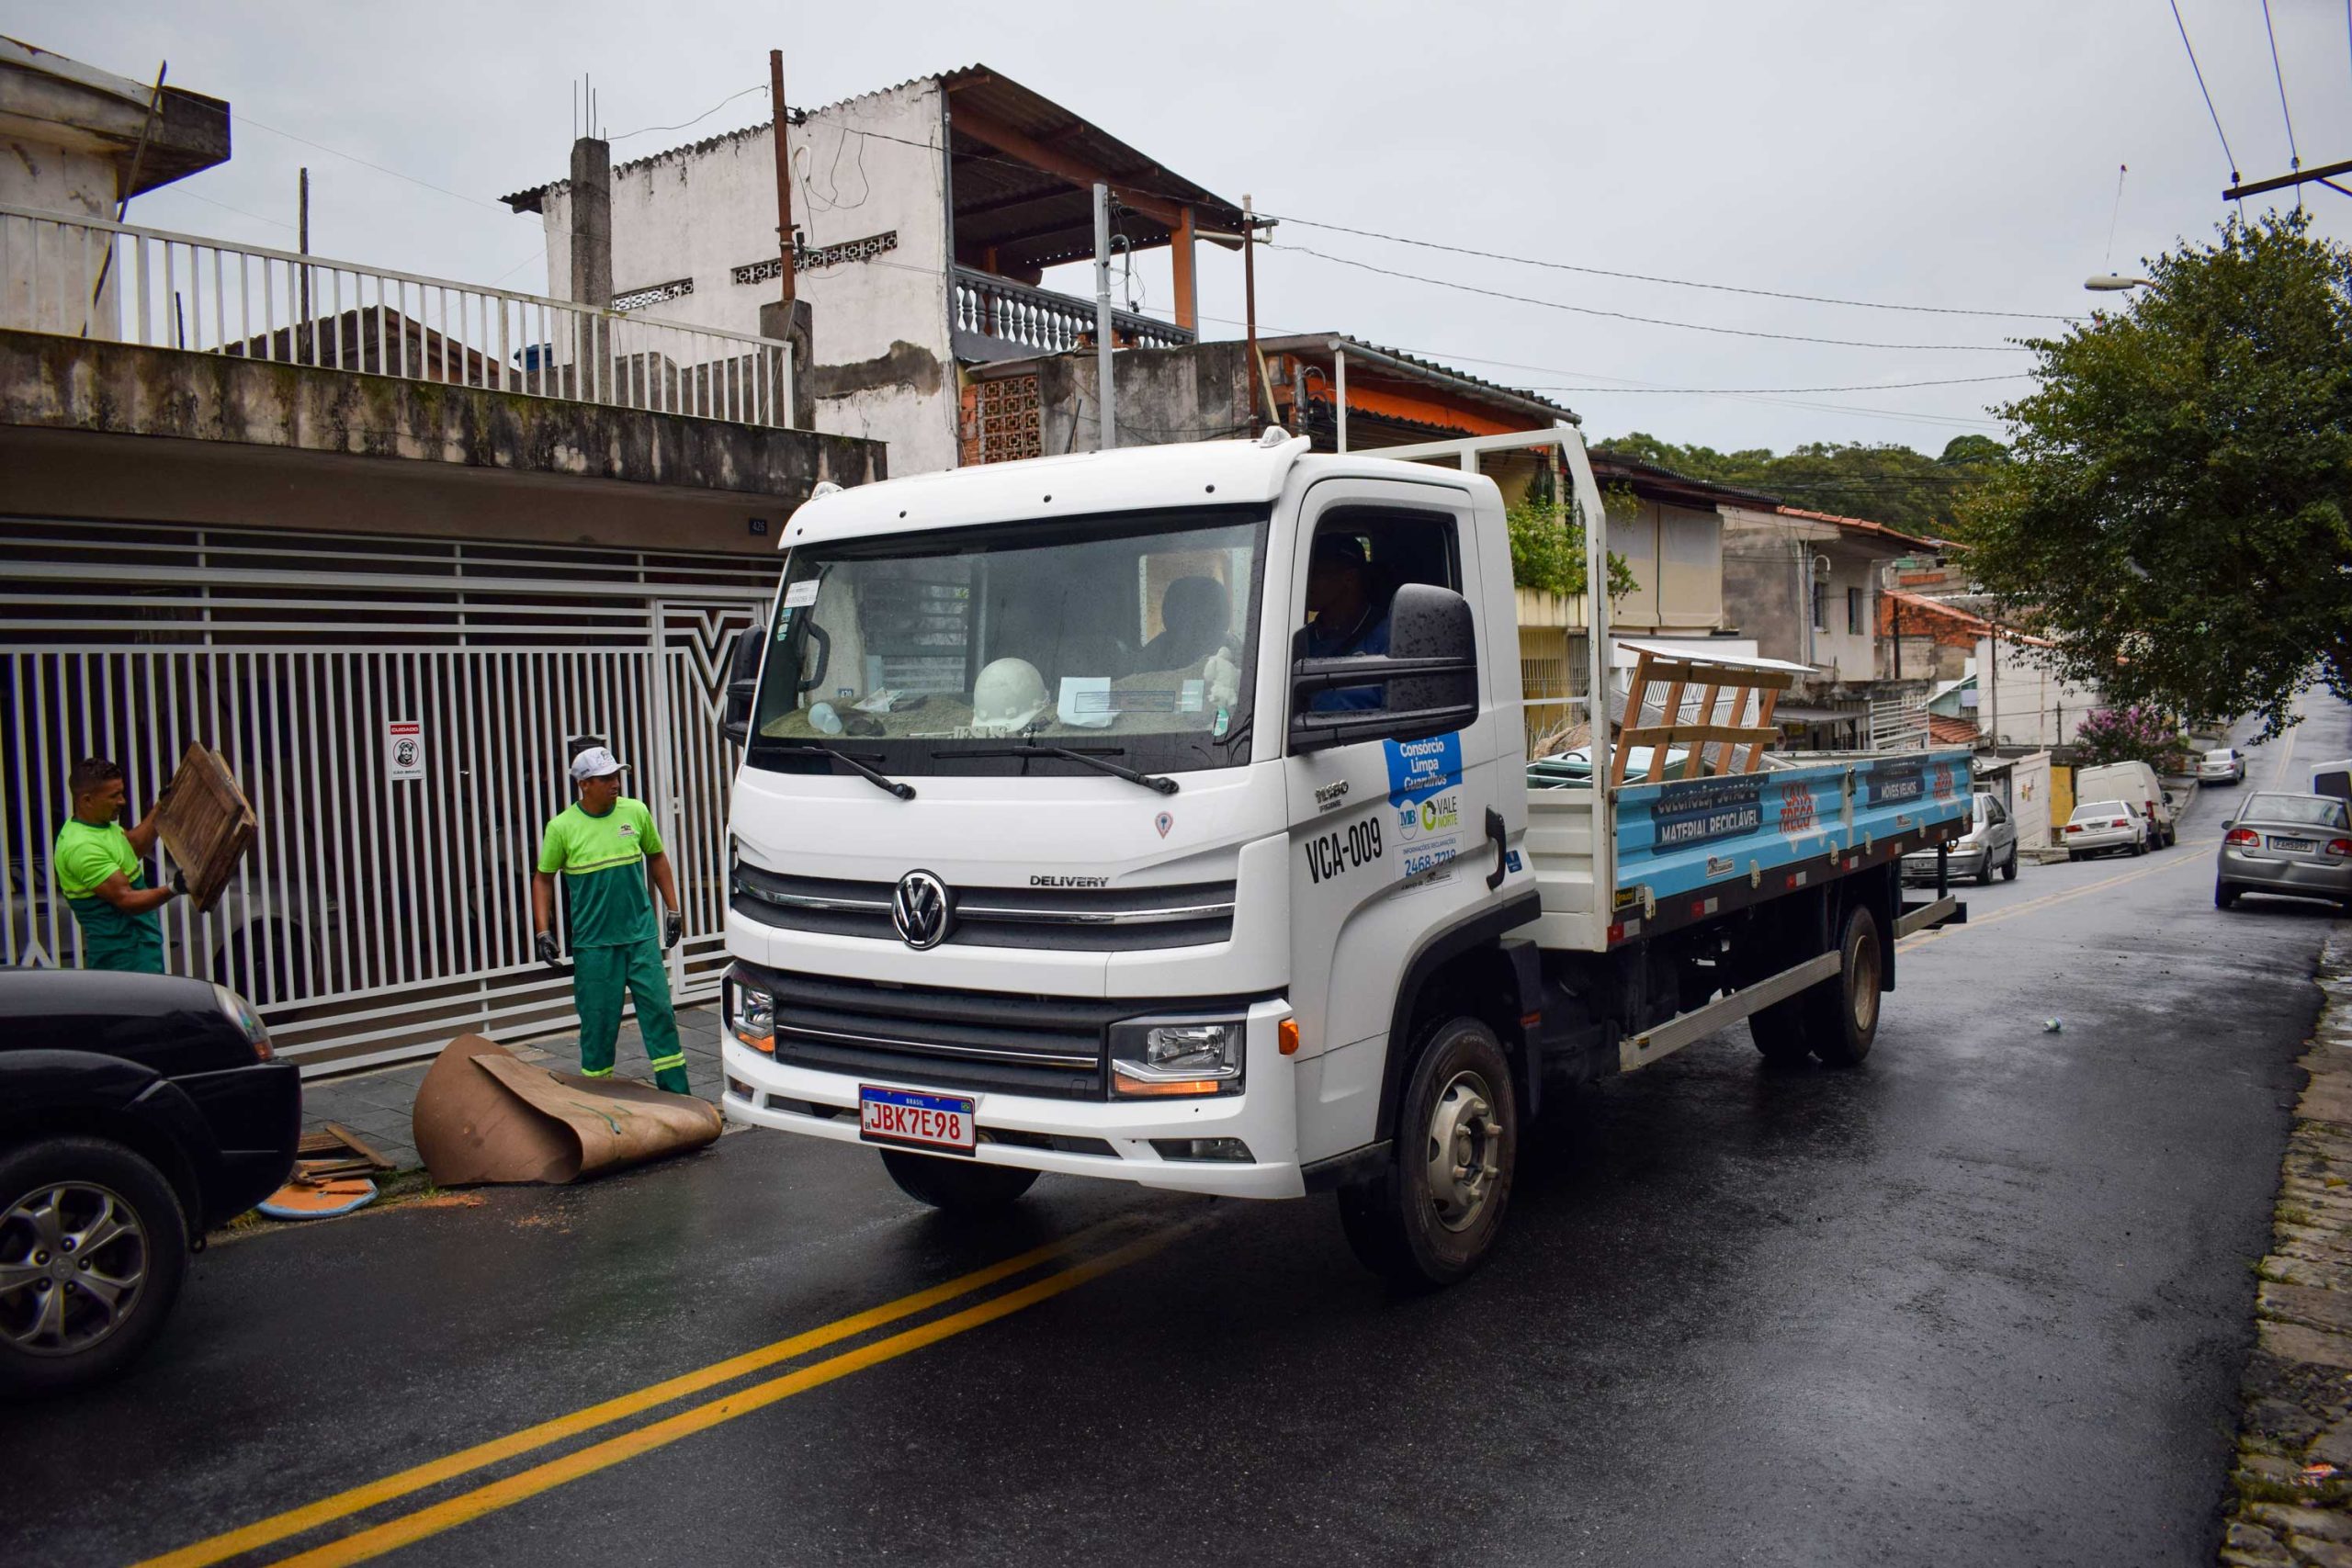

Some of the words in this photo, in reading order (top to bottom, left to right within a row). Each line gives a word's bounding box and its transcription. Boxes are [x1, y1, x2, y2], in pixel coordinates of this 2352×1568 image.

[1399, 737, 1444, 758] Consórcio
[1410, 757, 1439, 774] Limpa
[1404, 773, 1447, 792] Guarulhos
[1437, 796, 1457, 815] VALE
[1437, 813, 1457, 829] NORTE
[1661, 818, 1706, 844] MATERIAL
[1709, 807, 1759, 834] RECICLÁVEL
[1305, 817, 1382, 884] VCA-009
[1030, 875, 1110, 887] DELIVERY
[906, 1098, 924, 1107] BRASIL
[871, 1103, 961, 1140] JBK7E98
